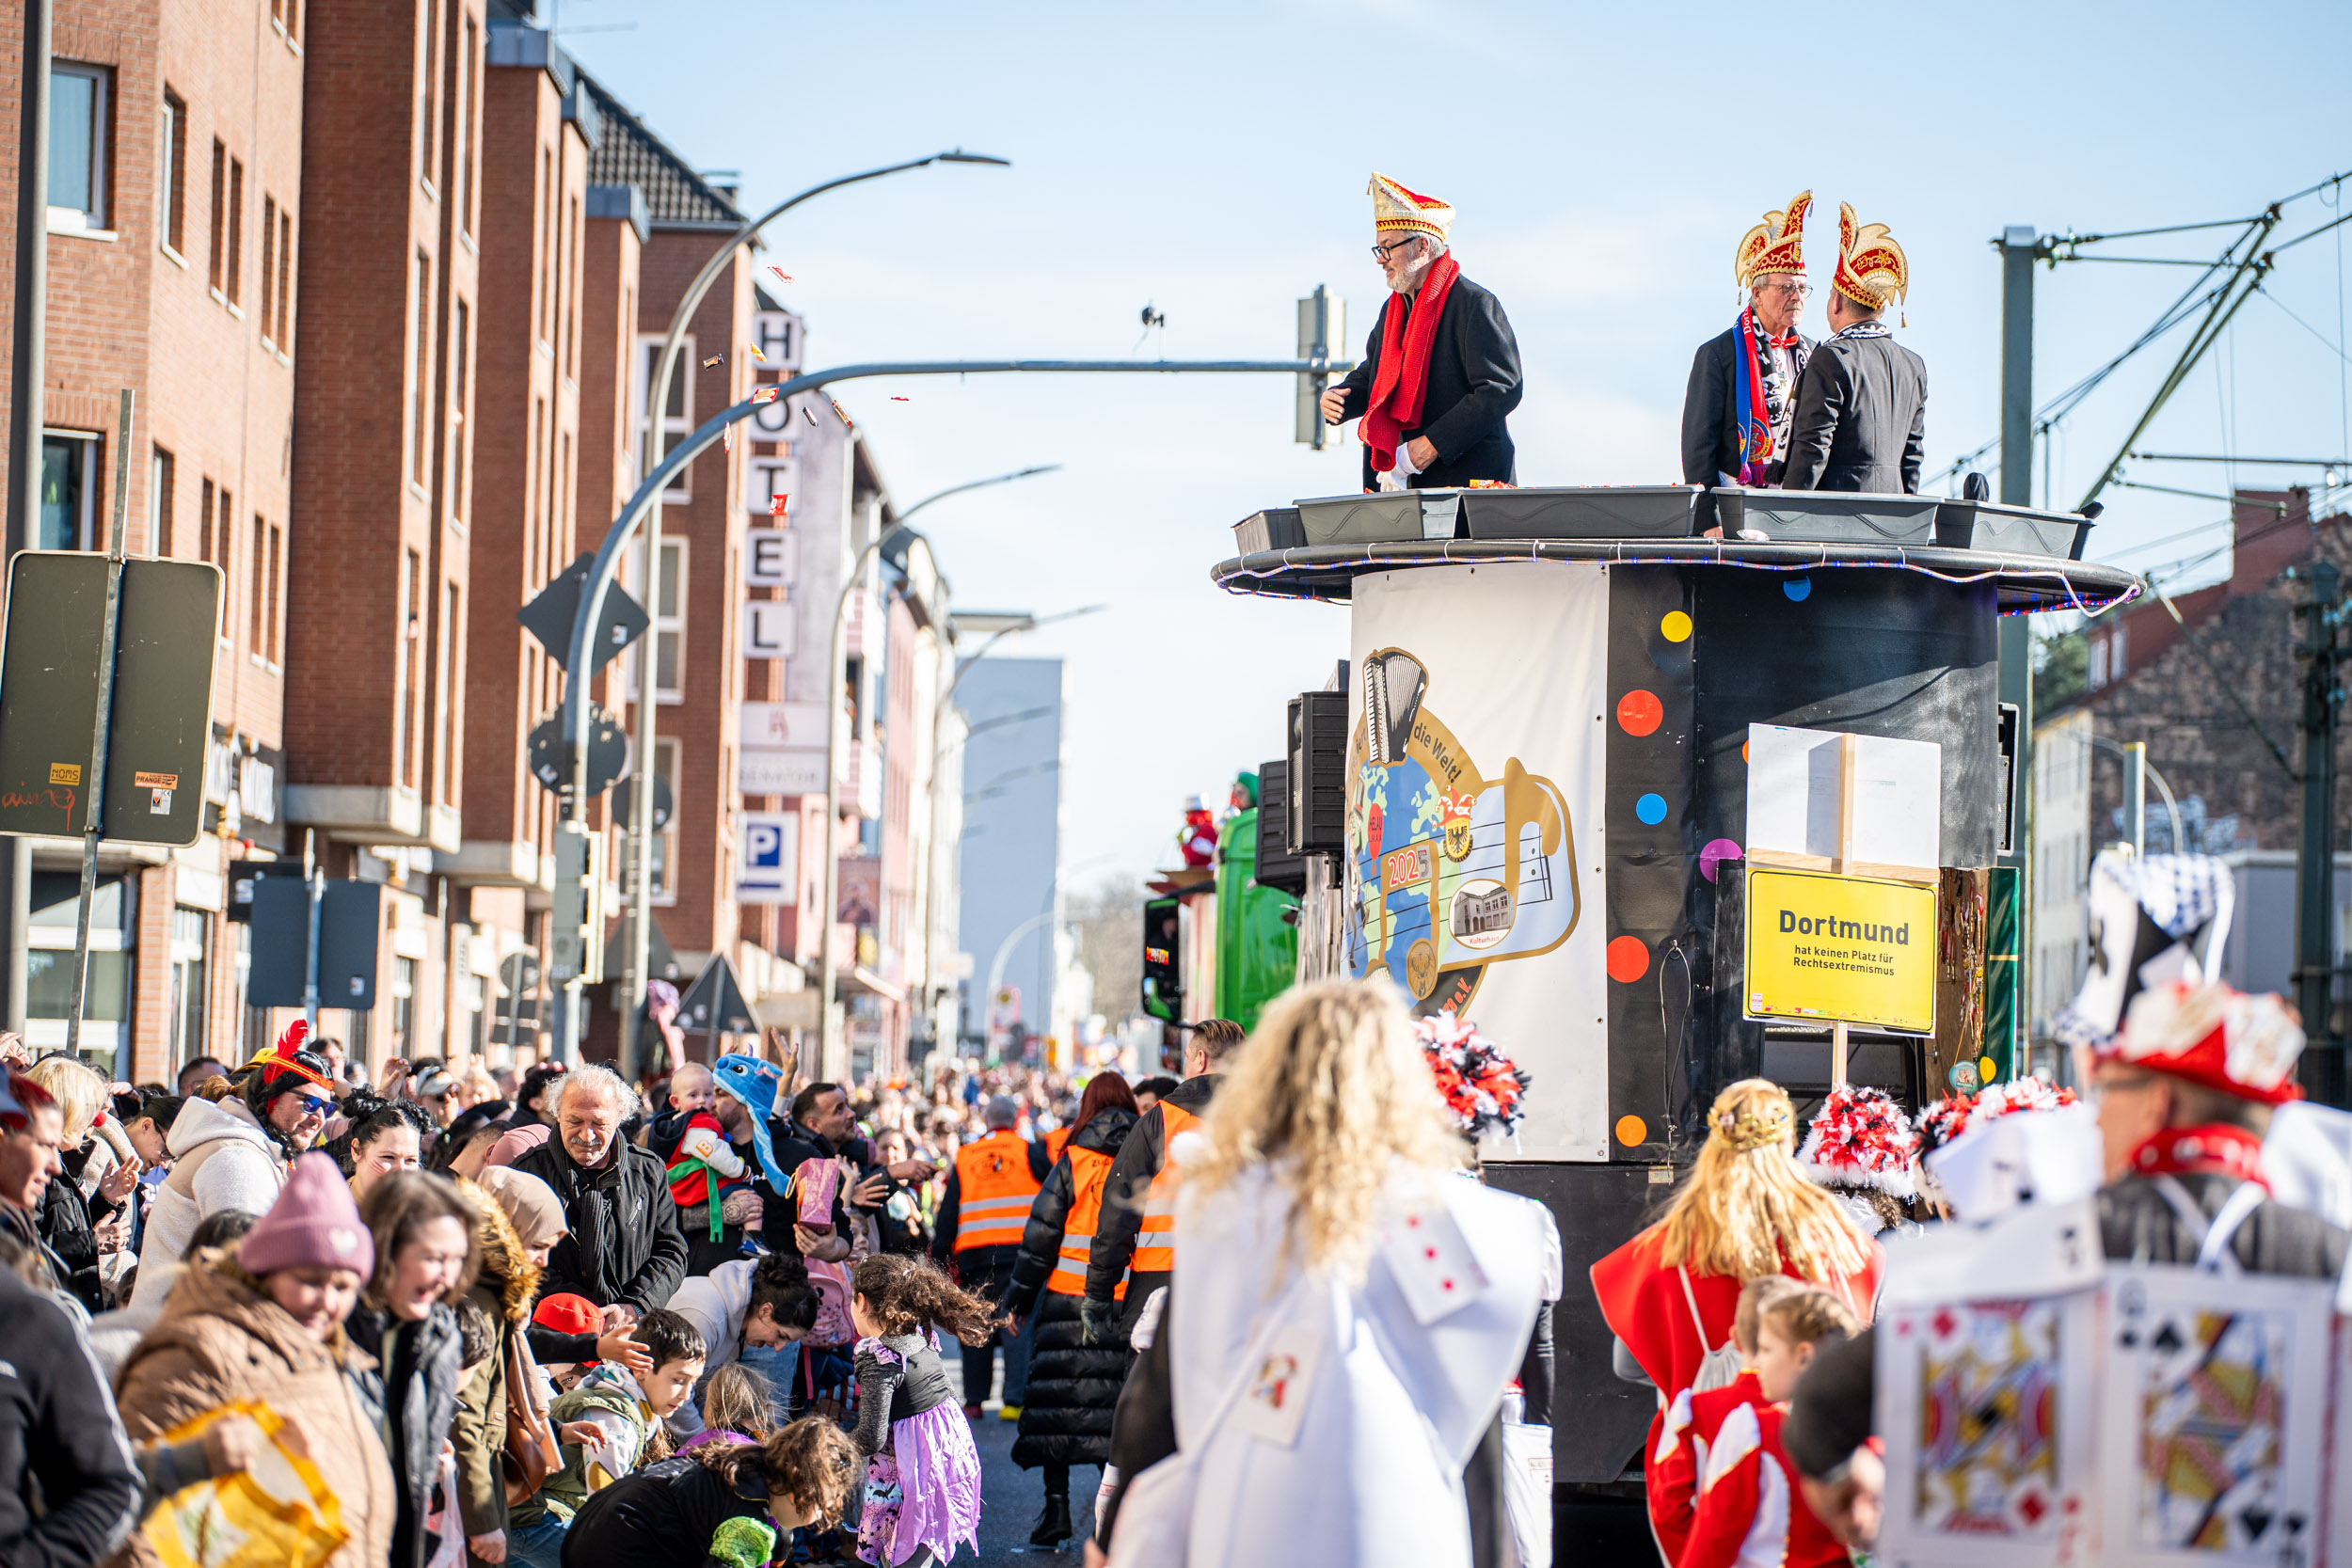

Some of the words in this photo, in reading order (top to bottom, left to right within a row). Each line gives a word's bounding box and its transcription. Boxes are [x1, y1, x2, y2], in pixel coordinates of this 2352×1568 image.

[754, 322, 791, 649] HOTEL
[1414, 722, 1431, 748] die
[1432, 737, 1462, 783] Welt!
[51, 768, 79, 781] NOMS
[136, 775, 162, 784] PRANGE
[1388, 849, 1429, 887] 2025
[1779, 910, 1909, 945] Dortmund
[1469, 936, 1500, 944] Kulturhaus
[1794, 945, 1811, 955] hat
[1814, 947, 1849, 958] keinen
[1851, 951, 1877, 961] Platz
[1879, 953, 1894, 963] für
[1793, 957, 1895, 975] Rechtsextremismus
[1454, 977, 1472, 1004] e.V.
